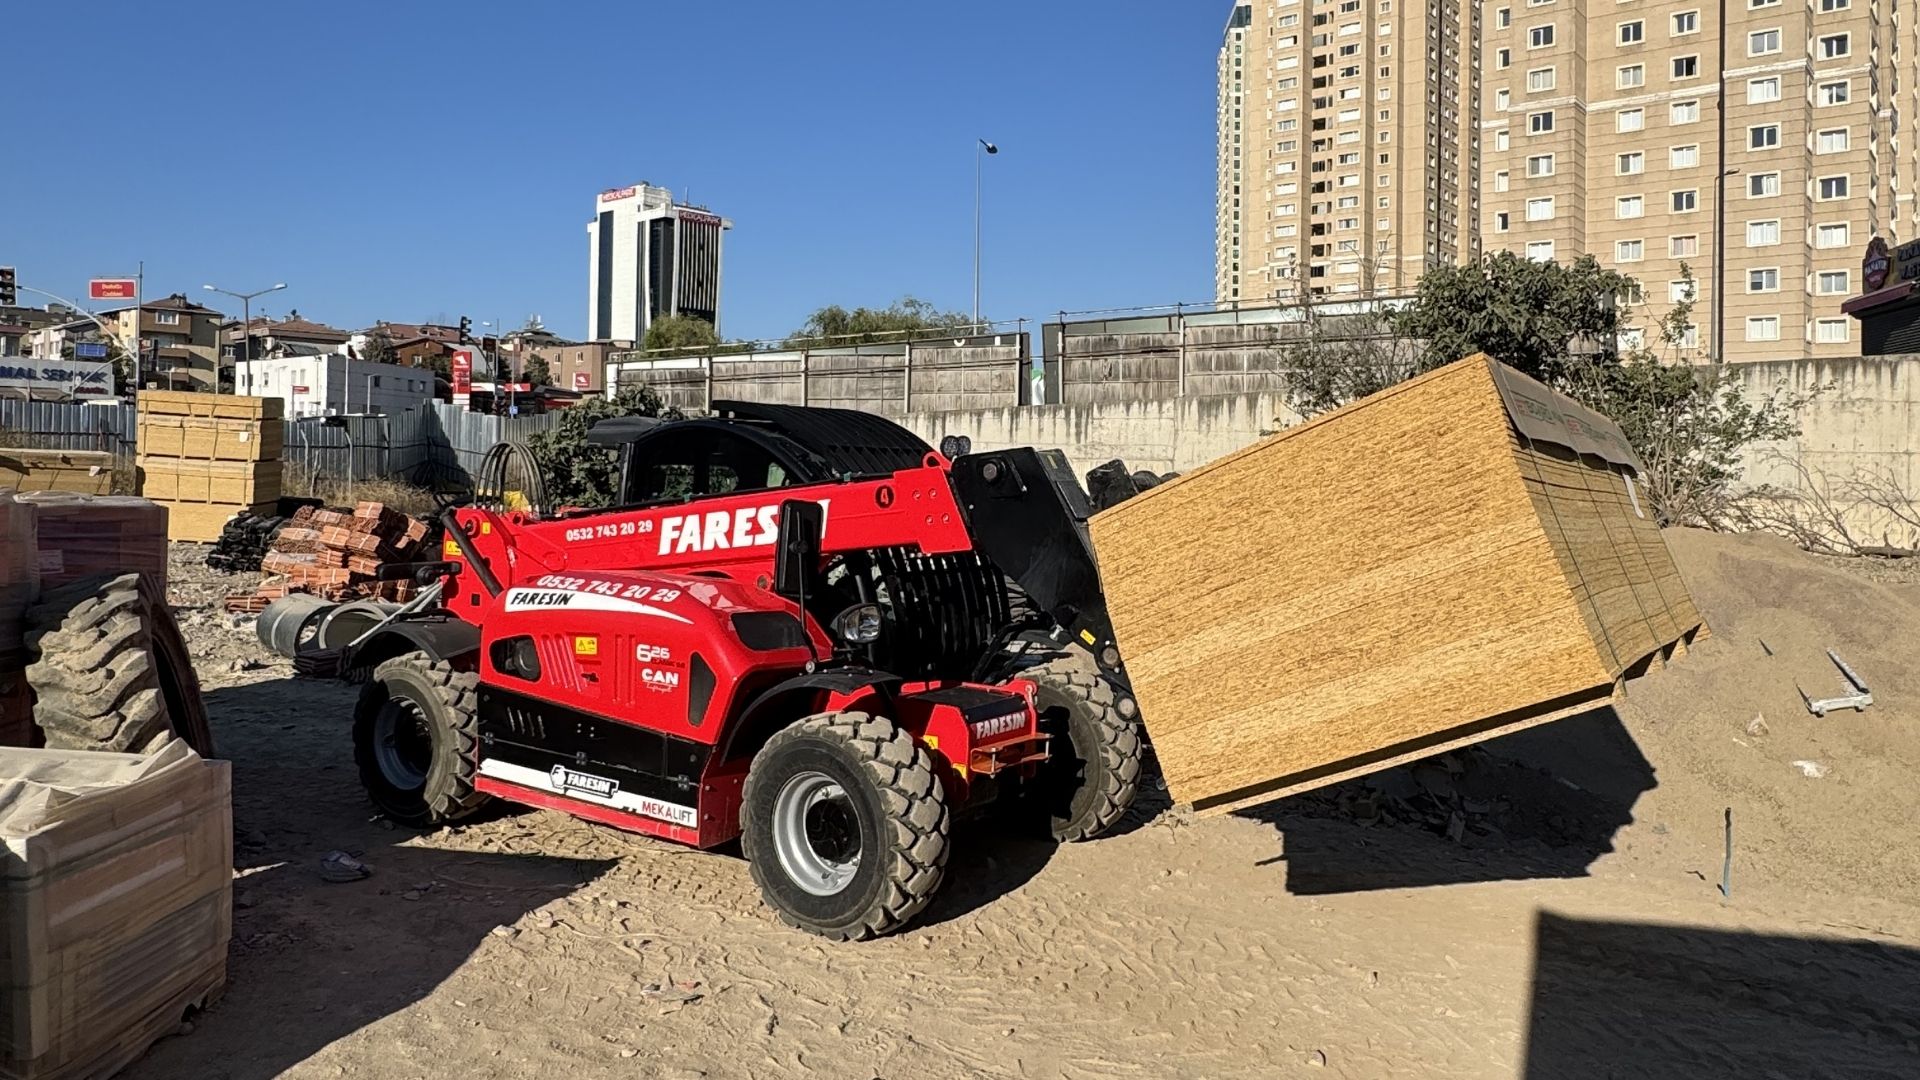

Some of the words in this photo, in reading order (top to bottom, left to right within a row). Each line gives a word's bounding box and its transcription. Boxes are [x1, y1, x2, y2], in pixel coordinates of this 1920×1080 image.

[566, 527, 594, 542] 0532
[597, 524, 617, 538] 743
[620, 522, 635, 535] 20
[638, 520, 653, 533] 29
[657, 498, 831, 556] FARES
[510, 592, 575, 606] FARESIN
[537, 575, 585, 590] 0532
[584, 580, 623, 595] 743
[621, 585, 651, 599] 20
[649, 588, 681, 602] 29
[637, 644, 670, 662] 626
[642, 668, 679, 685] CAN
[976, 711, 1025, 739] FARESIN
[567, 773, 611, 793] FARESIN
[641, 801, 693, 822] MEKALIFT
